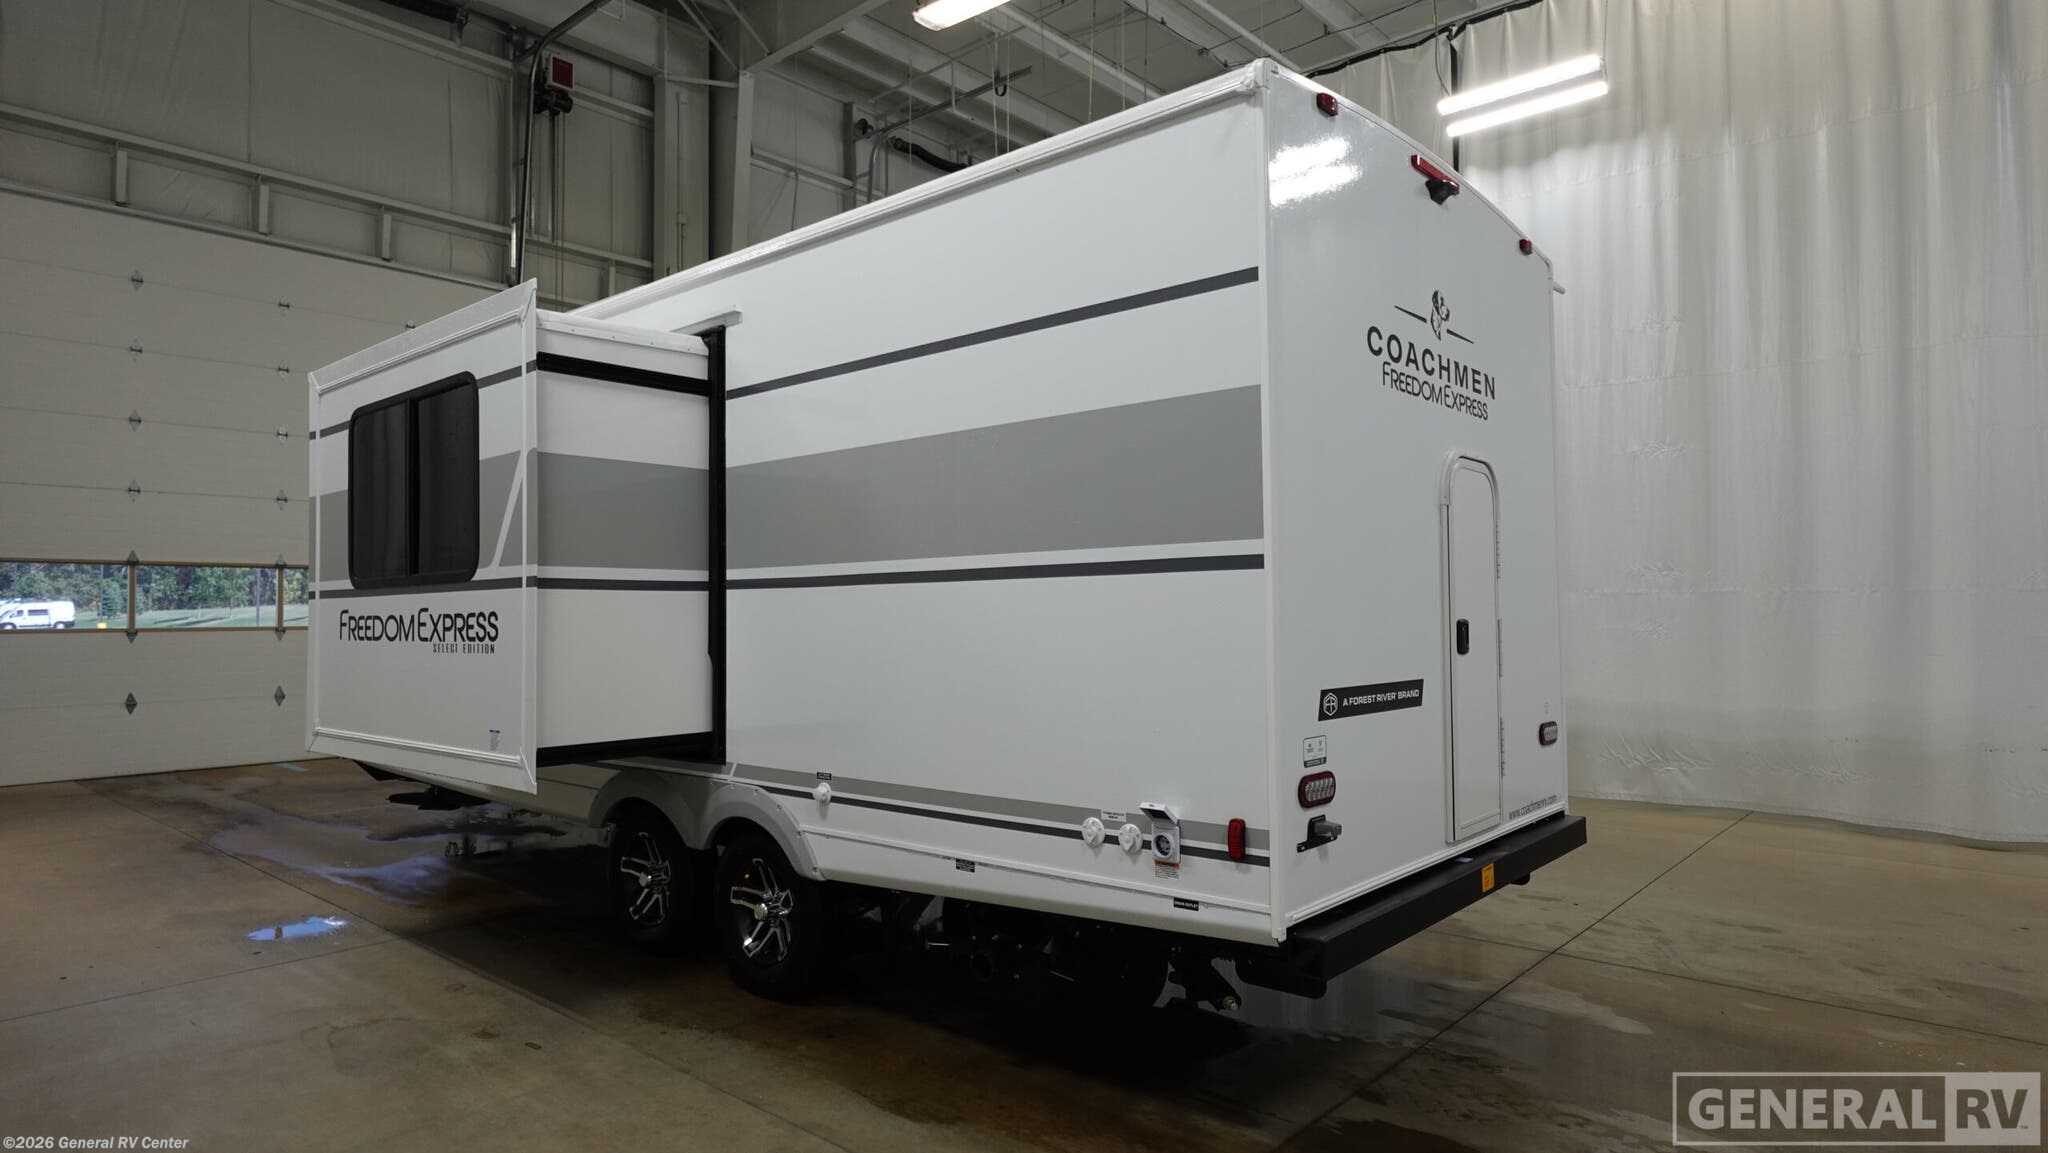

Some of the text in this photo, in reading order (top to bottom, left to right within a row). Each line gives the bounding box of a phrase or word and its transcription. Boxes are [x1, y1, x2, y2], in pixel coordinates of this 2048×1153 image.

[1366, 325, 1496, 400] COACHMEN
[432, 643, 495, 655] SELECT EDITION
[1342, 698, 1349, 707] A
[1349, 695, 1376, 706] FOREST
[1397, 689, 1420, 700] BRAND
